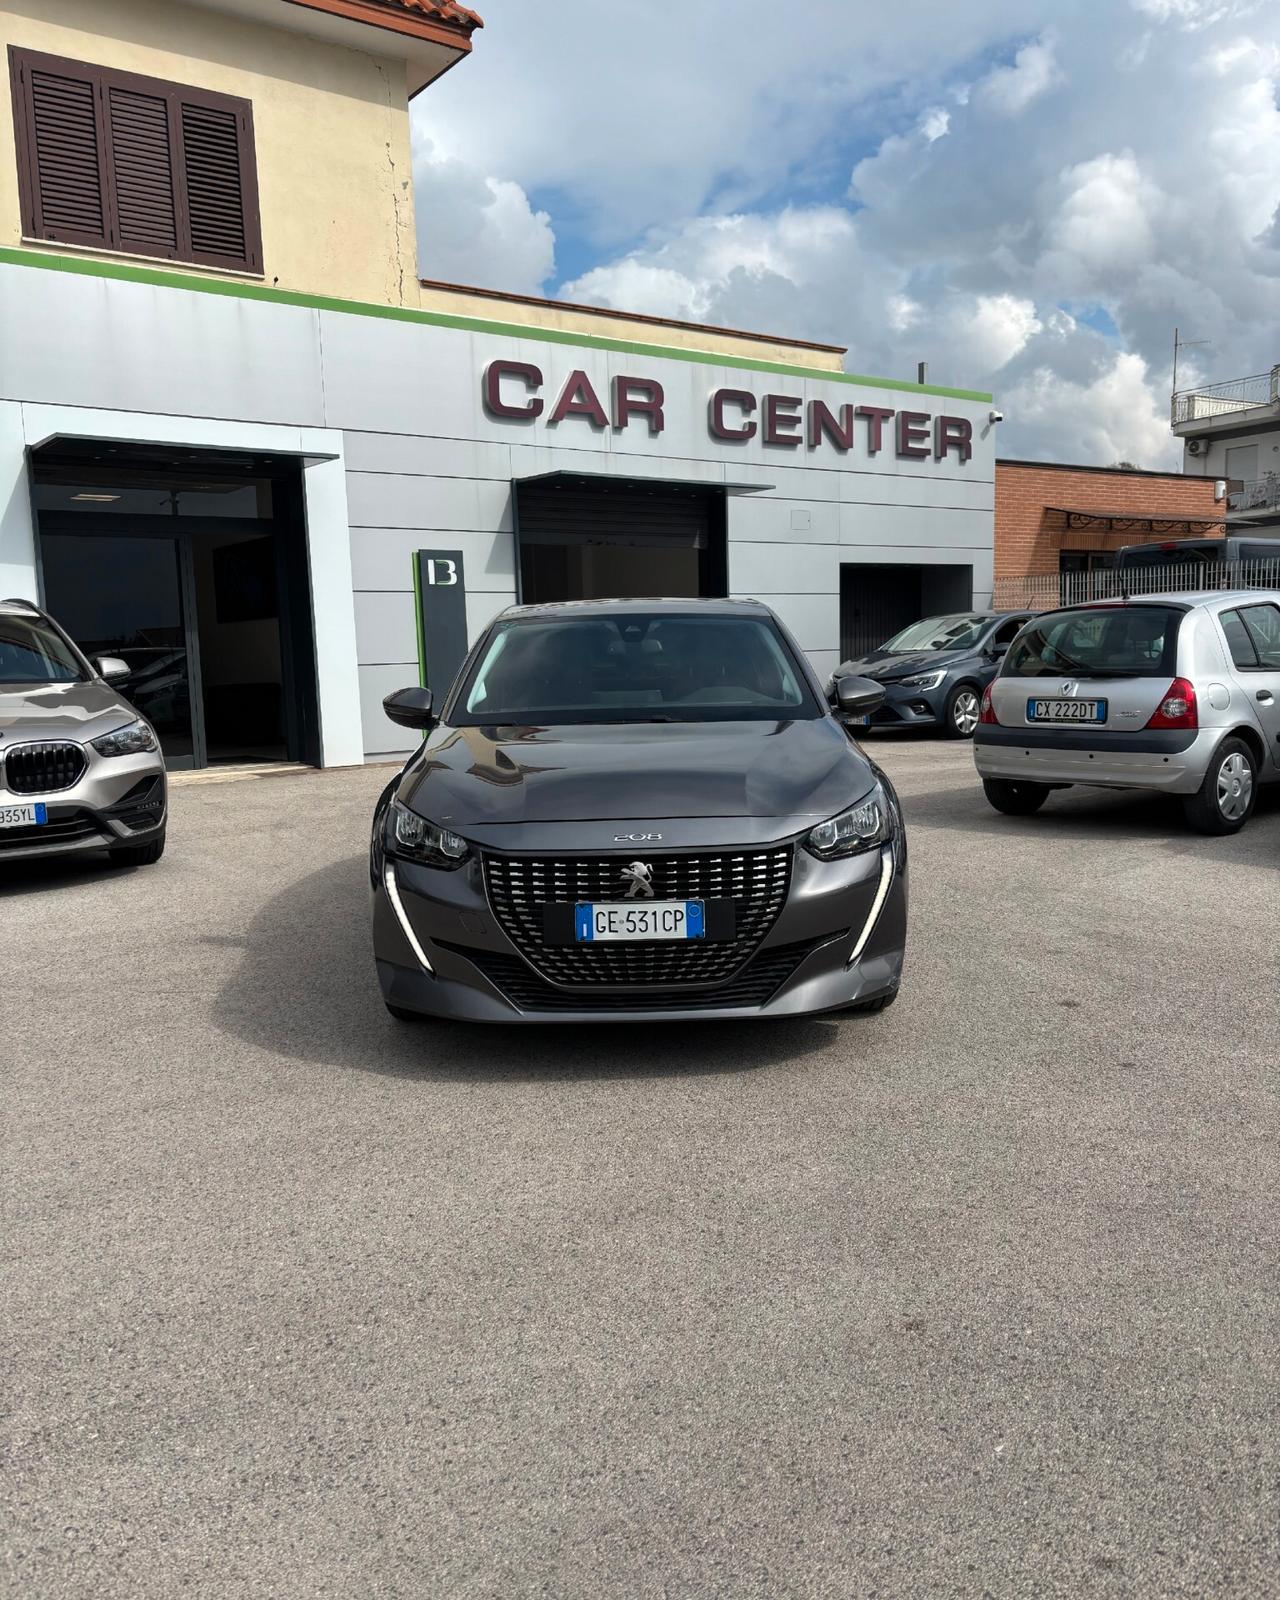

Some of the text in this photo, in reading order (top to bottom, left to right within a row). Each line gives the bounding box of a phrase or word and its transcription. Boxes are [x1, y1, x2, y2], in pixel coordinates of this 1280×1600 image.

[486, 359, 973, 461] CAR CENTER
[1036, 702, 1051, 717] CX
[1055, 703, 1096, 718] 222DT
[613, 833, 663, 842] 208
[595, 910, 684, 933] GE 531CP
